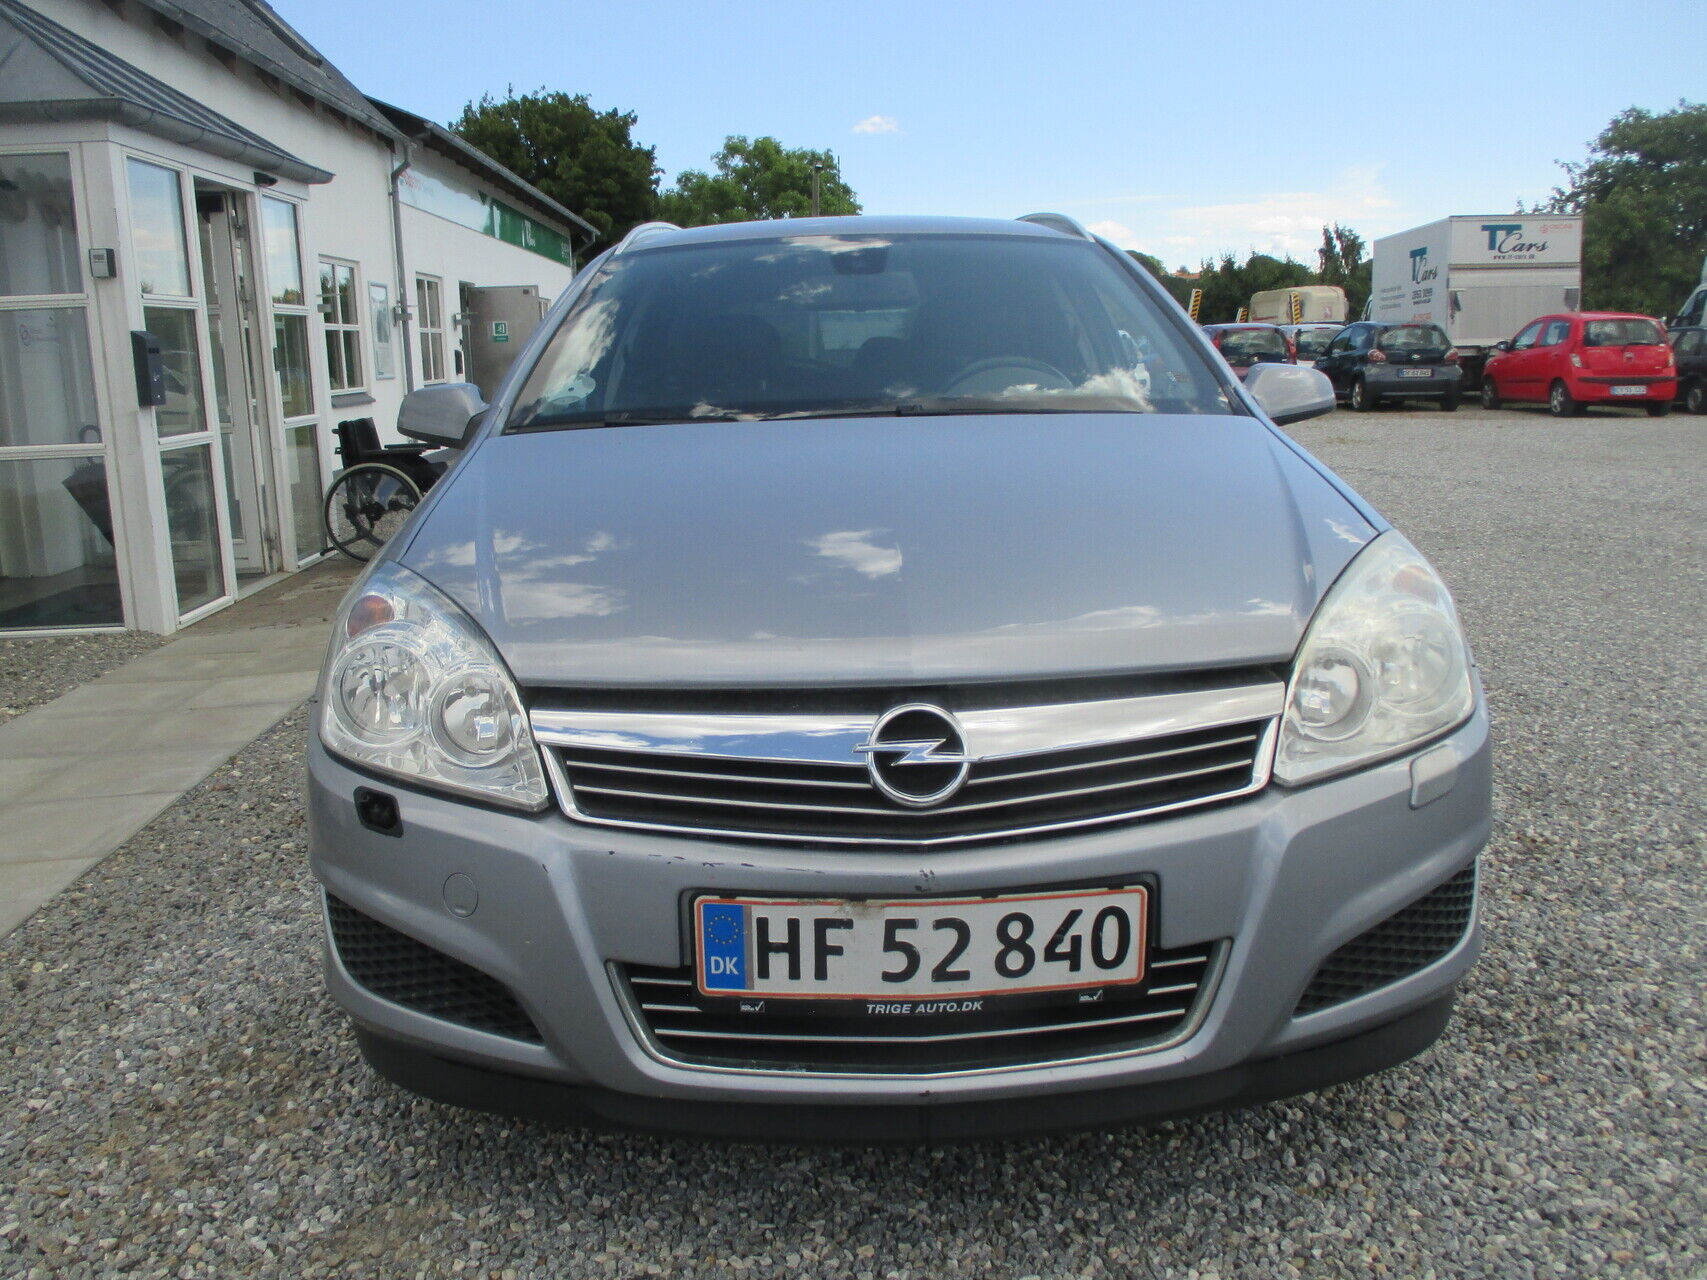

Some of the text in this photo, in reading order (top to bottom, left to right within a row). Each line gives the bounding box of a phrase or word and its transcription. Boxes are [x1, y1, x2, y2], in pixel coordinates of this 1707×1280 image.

[1498, 232, 1548, 254] Cars
[756, 906, 1132, 983] HF 52 840
[710, 957, 739, 975] DK
[866, 1000, 983, 1014] TRIGE AUTO.DK
